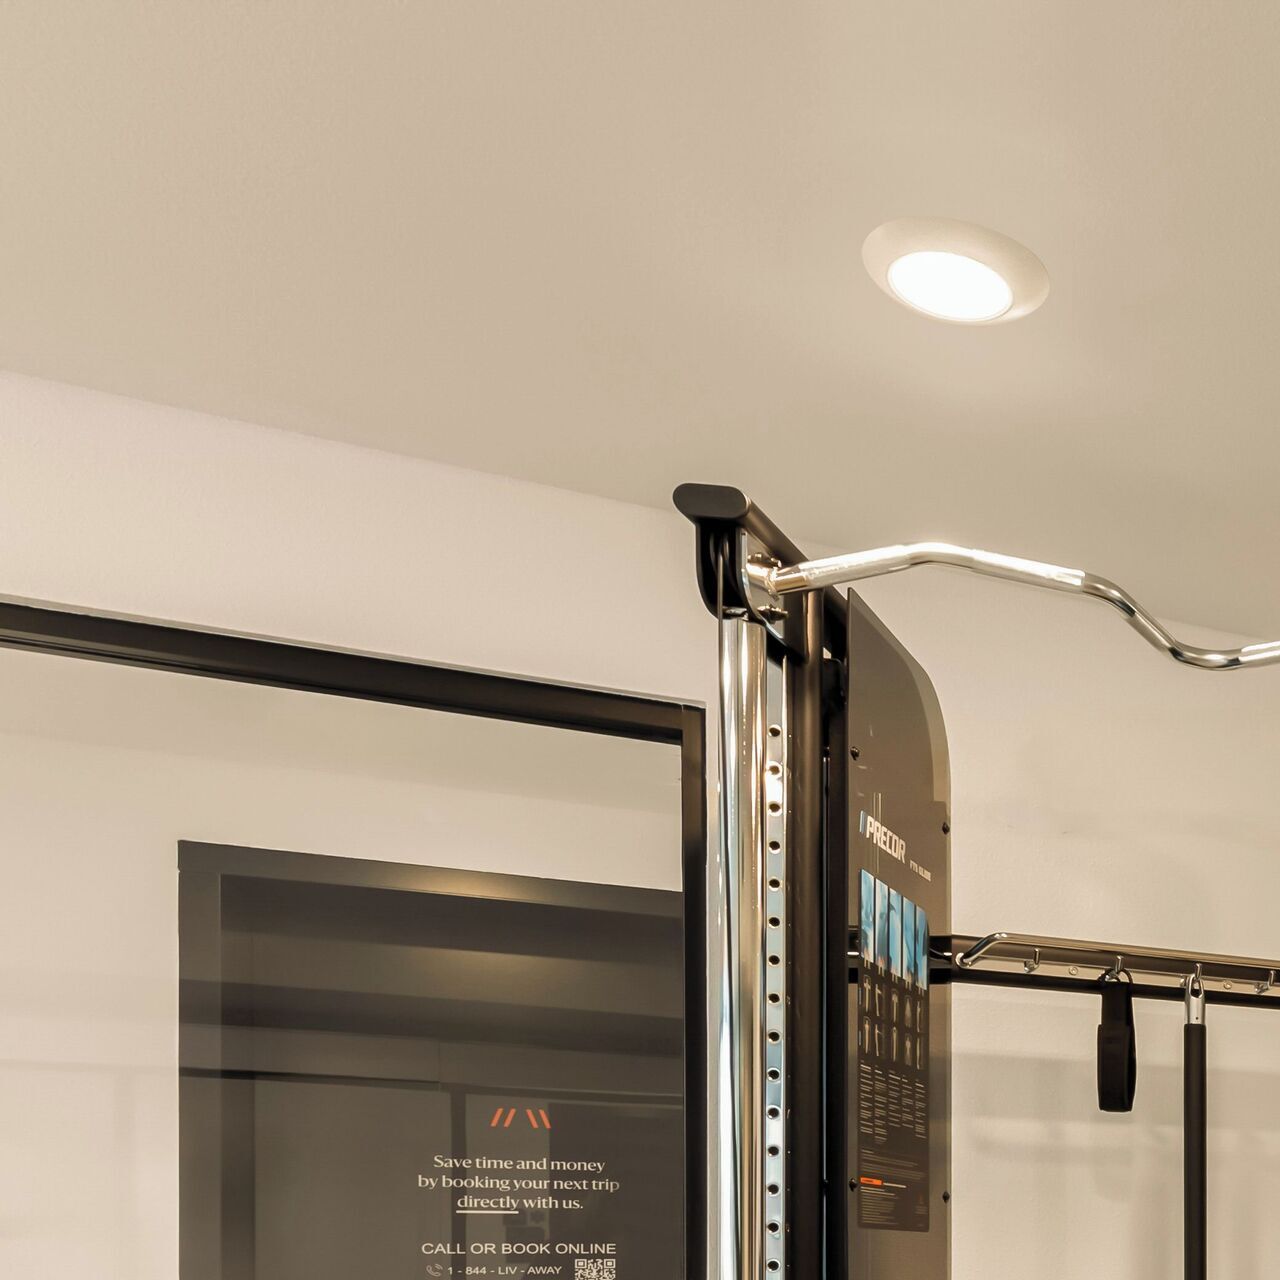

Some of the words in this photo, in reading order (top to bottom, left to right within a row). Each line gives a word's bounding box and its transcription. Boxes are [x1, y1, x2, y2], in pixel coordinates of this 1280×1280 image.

[866, 816, 906, 863] PRECOR
[433, 1155, 472, 1169] Save
[476, 1157, 513, 1169] time
[517, 1158, 547, 1170] and
[551, 1160, 606, 1172] money
[418, 1175, 438, 1189] by
[442, 1175, 511, 1191] booking
[514, 1178, 550, 1191] your
[554, 1178, 588, 1190] next
[592, 1178, 619, 1192] trip
[457, 1196, 519, 1210] directly
[522, 1196, 558, 1208] with
[562, 1199, 583, 1209] us.
[421, 1243, 466, 1254] CALL
[471, 1243, 496, 1254] OR
[502, 1243, 550, 1254] BOOK
[556, 1243, 616, 1254] ONLINE
